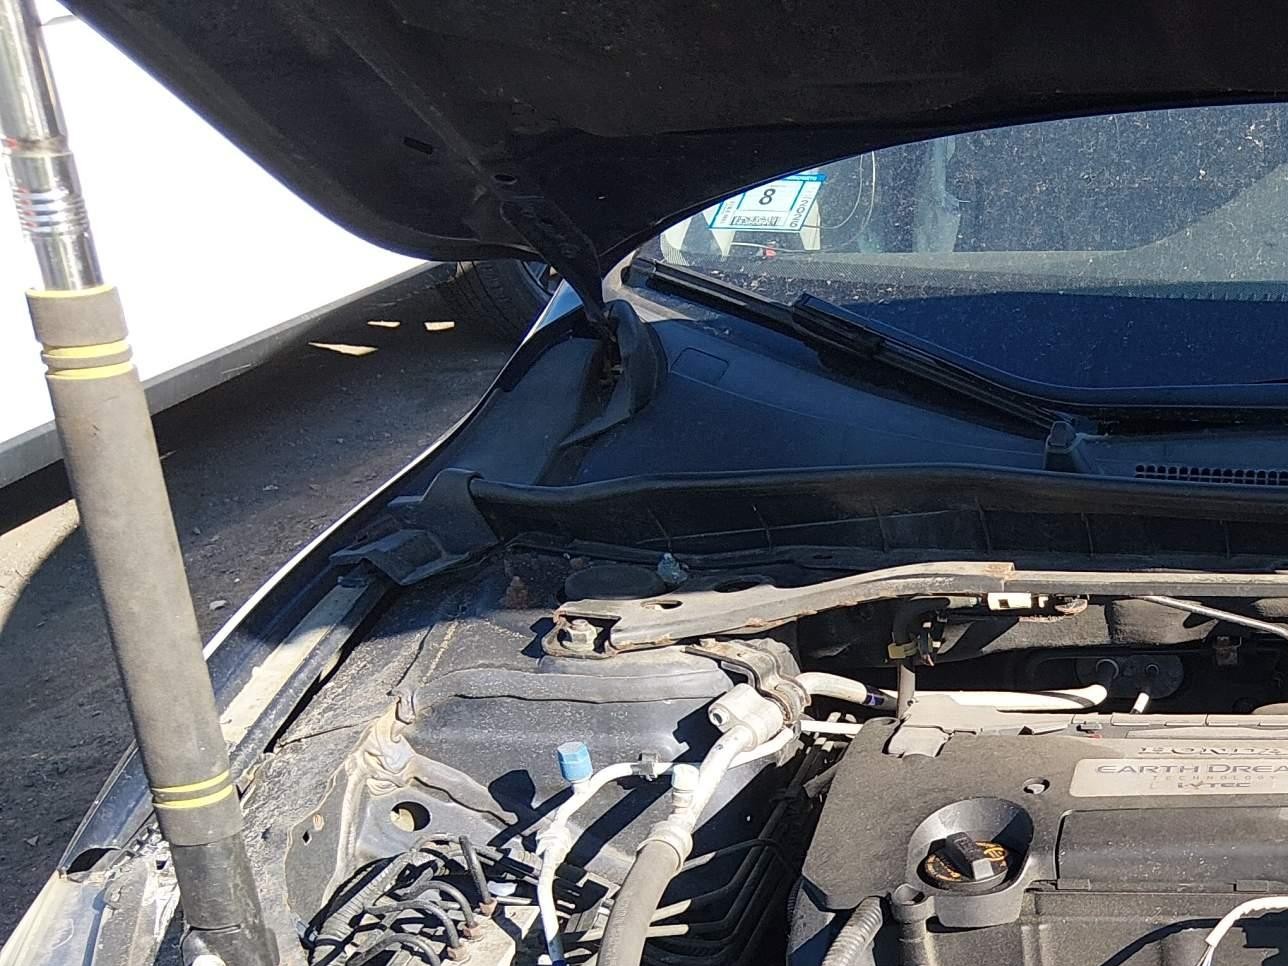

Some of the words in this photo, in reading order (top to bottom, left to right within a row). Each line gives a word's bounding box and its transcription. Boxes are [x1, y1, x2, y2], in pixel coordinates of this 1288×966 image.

[758, 188, 777, 206] 8
[789, 199, 809, 228] 2026
[1096, 764, 1200, 774] EARTH
